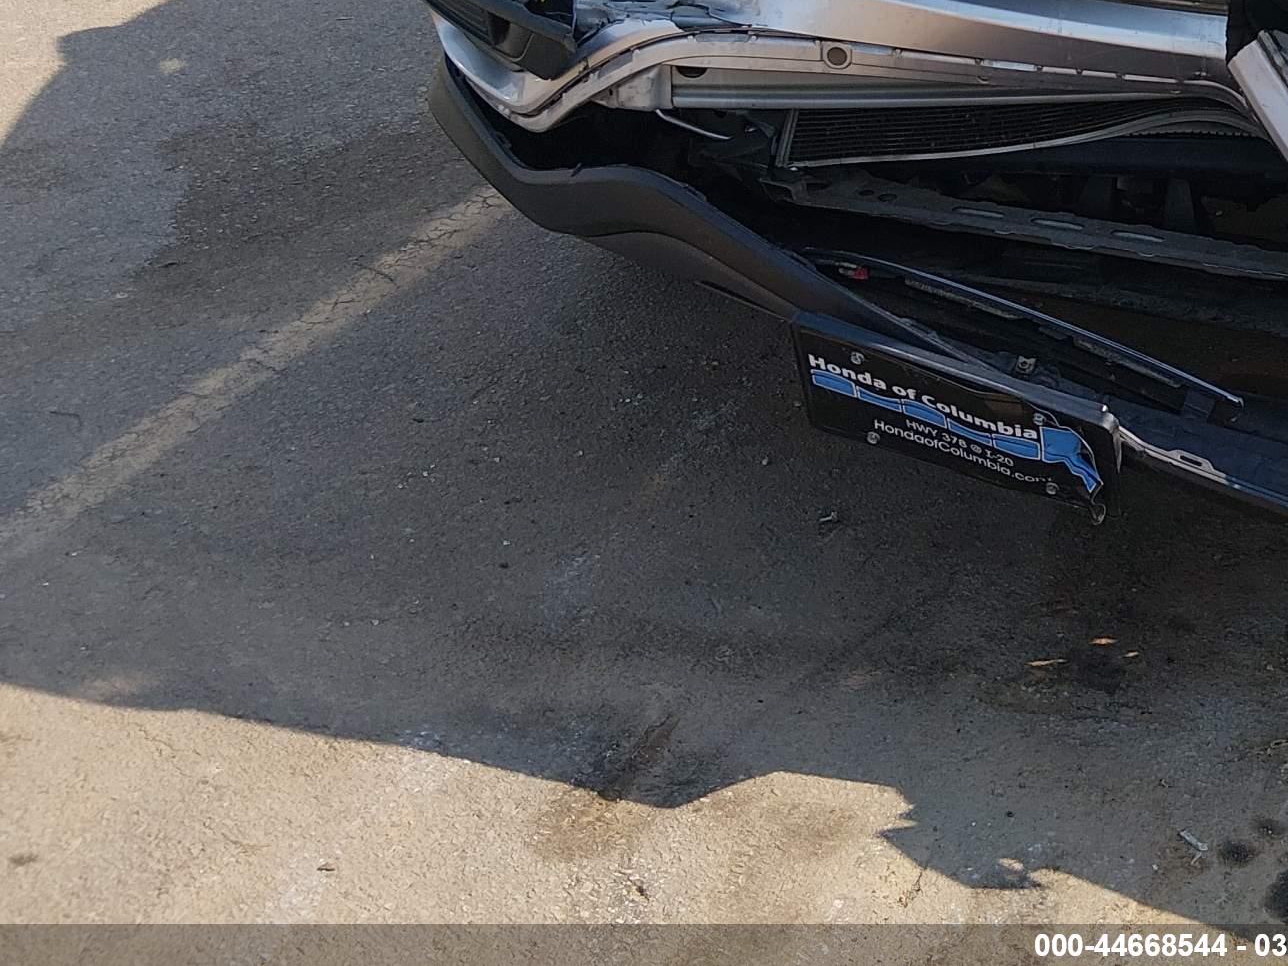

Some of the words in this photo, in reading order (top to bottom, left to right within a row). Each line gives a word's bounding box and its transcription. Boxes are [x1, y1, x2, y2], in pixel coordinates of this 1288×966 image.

[808, 354, 887, 390] Honda
[892, 386, 917, 400] of
[921, 394, 1038, 439] Columbia
[906, 419, 938, 437] HWY
[942, 432, 967, 449] 378
